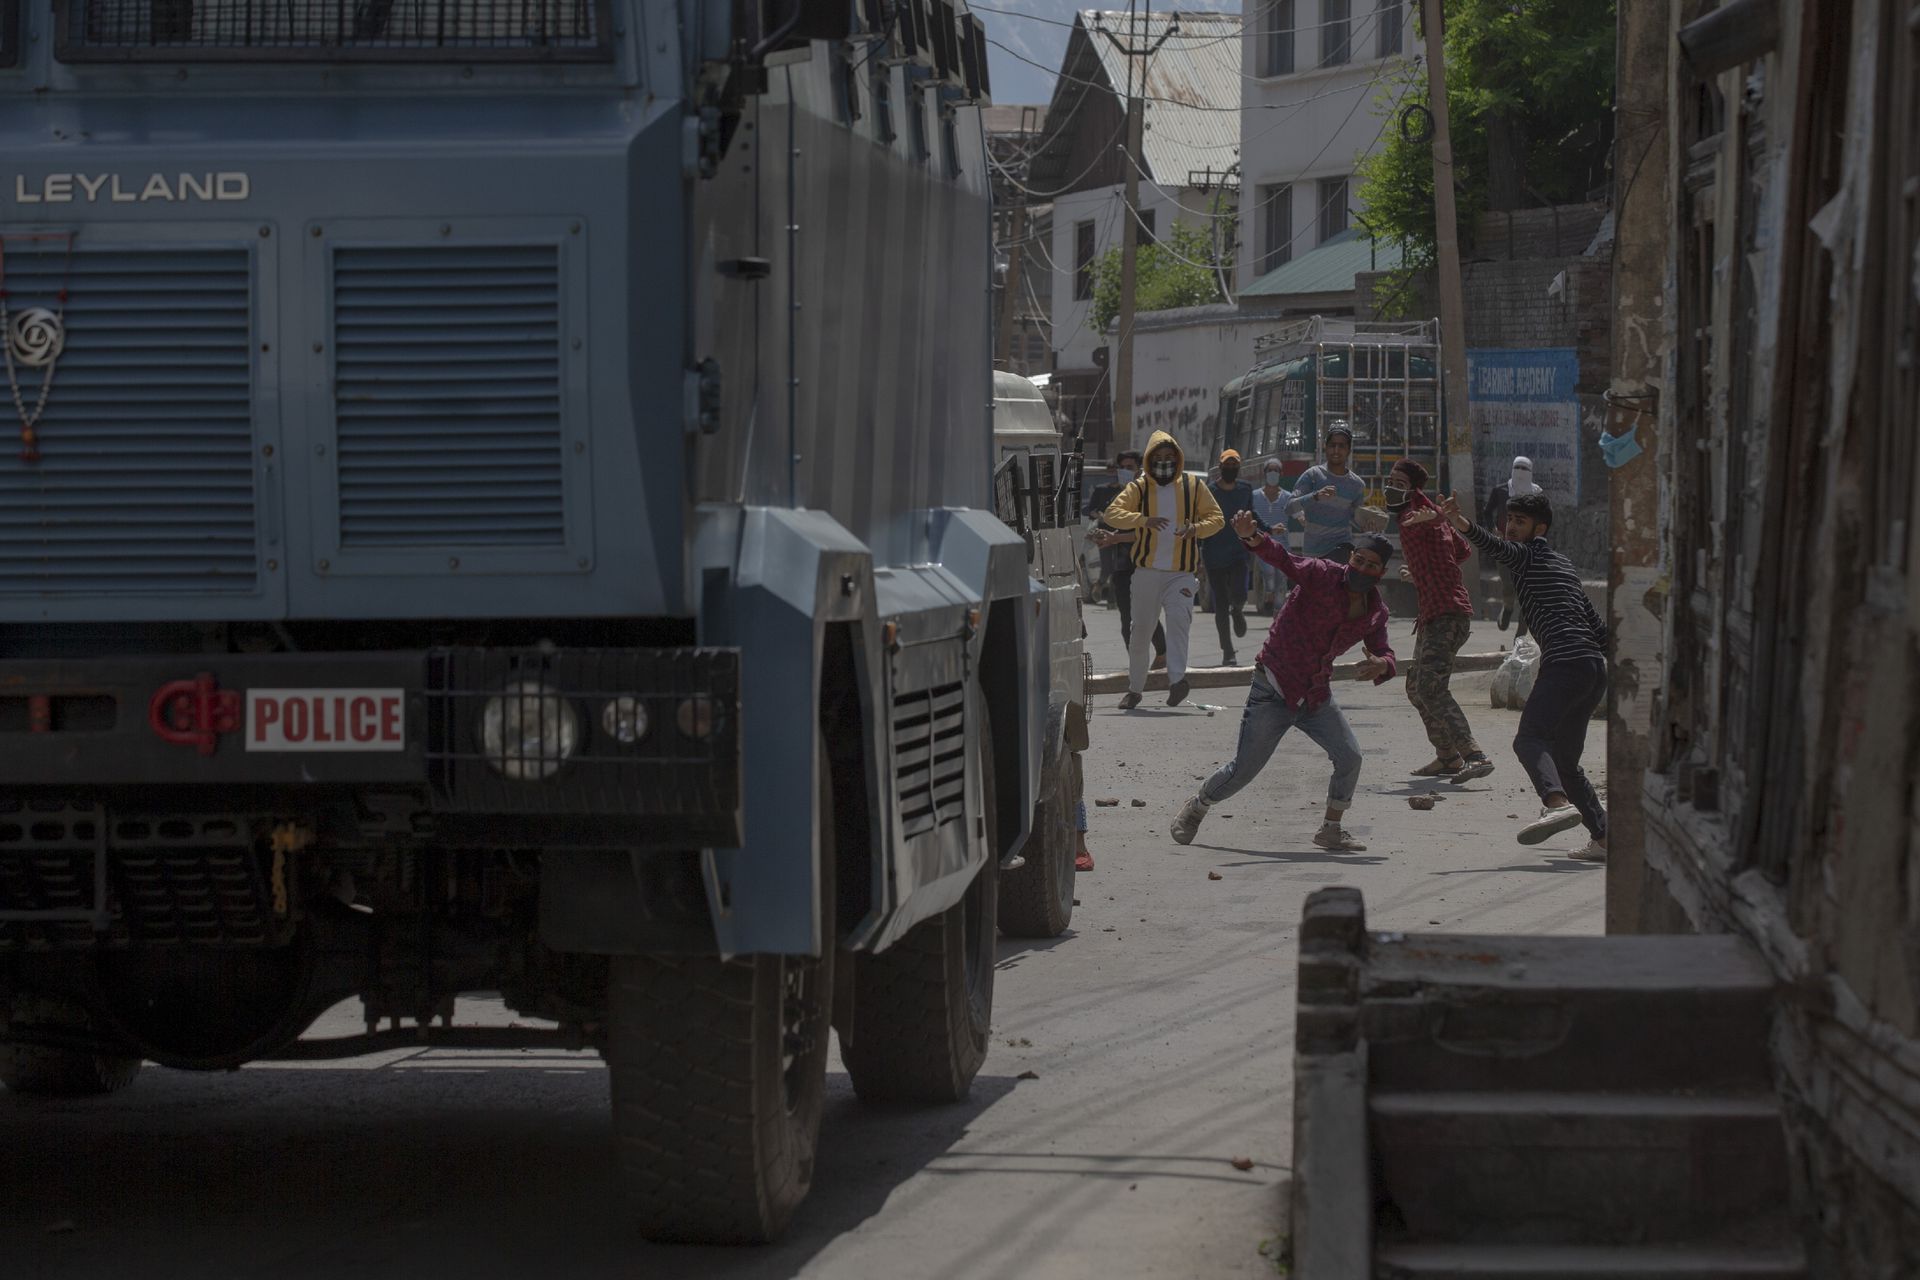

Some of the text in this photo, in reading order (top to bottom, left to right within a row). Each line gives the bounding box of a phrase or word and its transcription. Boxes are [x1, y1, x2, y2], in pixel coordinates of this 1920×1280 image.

[15, 172, 250, 203] LEYLAND
[1478, 367, 1515, 395] LEARNING
[1516, 367, 1557, 395] ACADEMY
[254, 696, 401, 743] POLICE
